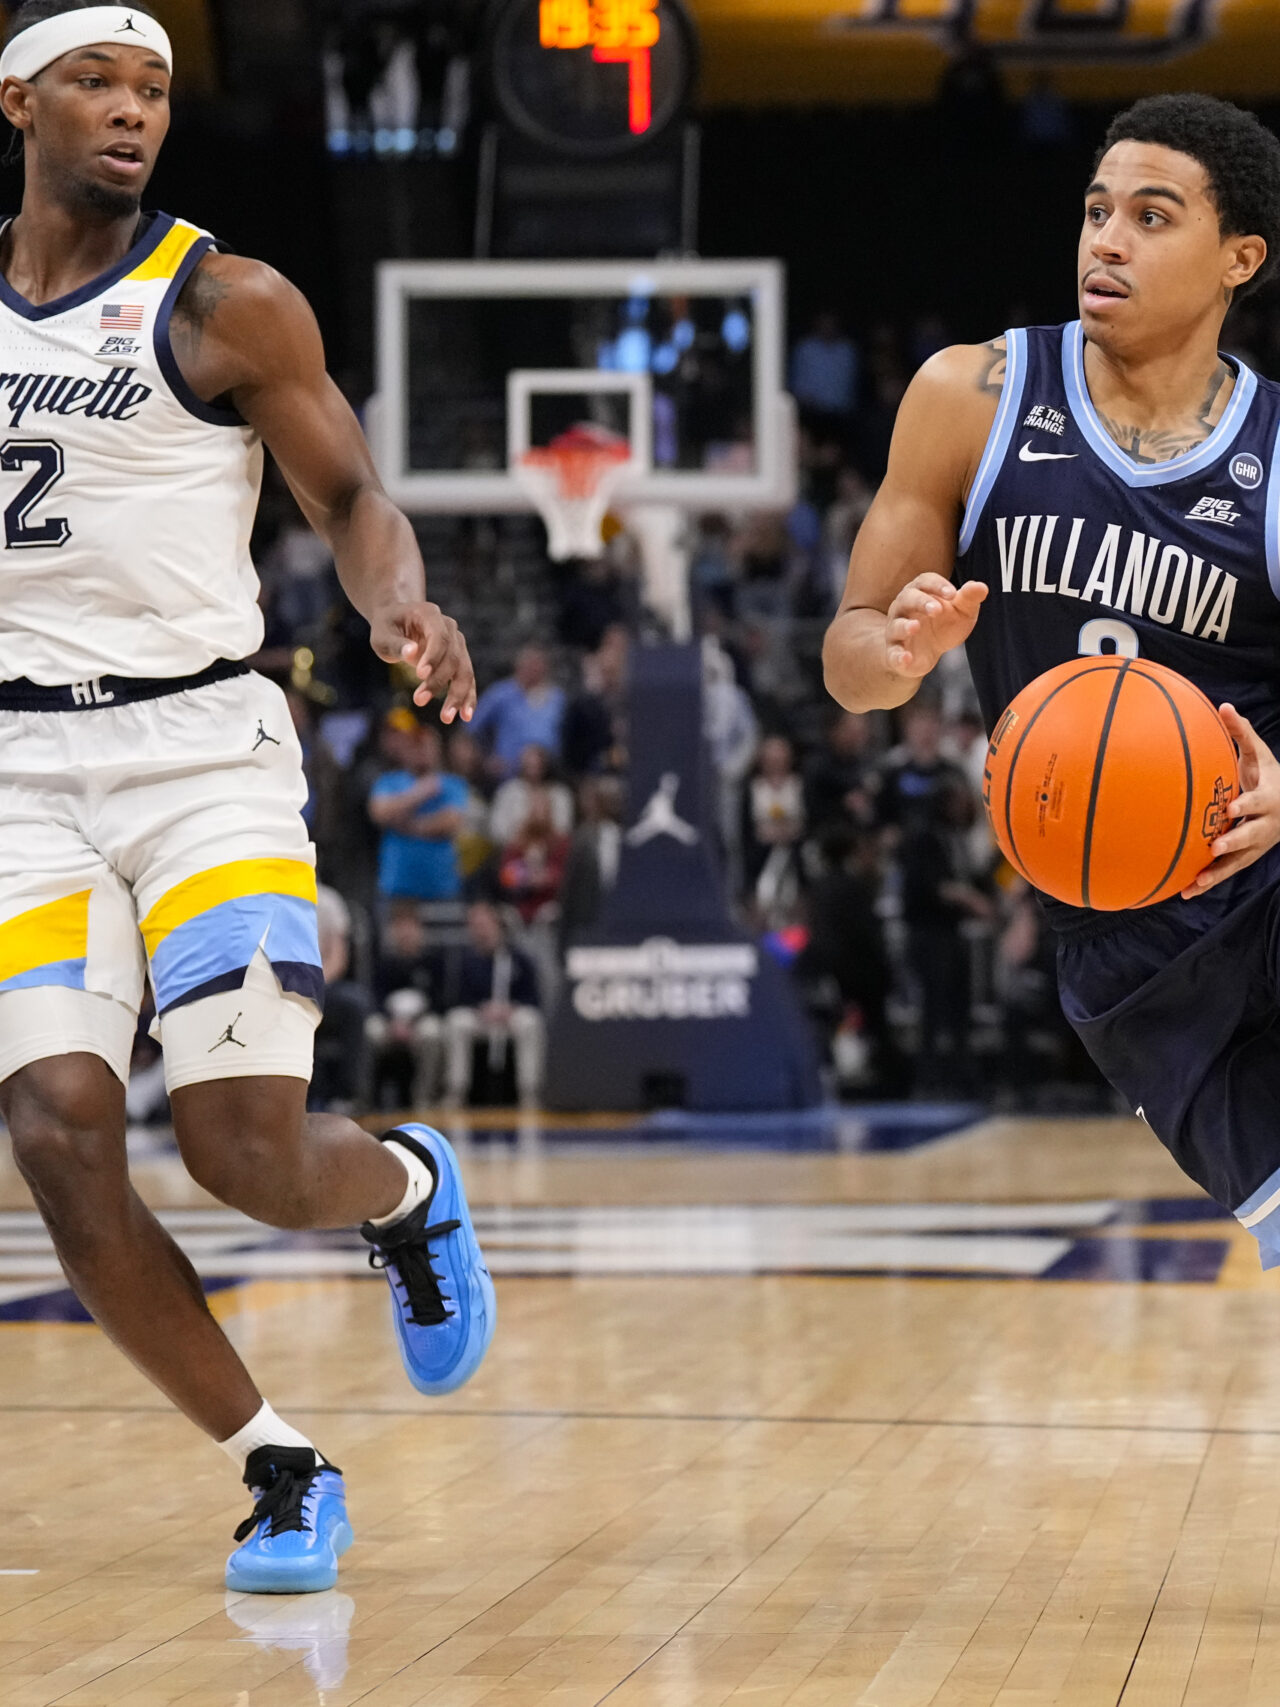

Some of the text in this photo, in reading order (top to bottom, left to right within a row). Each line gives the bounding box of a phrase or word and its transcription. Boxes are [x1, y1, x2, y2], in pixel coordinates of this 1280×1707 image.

[98, 346, 142, 354] EAST
[105, 336, 136, 345] BIG
[1023, 414, 1065, 437] CHANGE
[1030, 405, 1067, 426] BE THE
[1235, 461, 1258, 481] GHR
[0, 439, 72, 550] 2
[1196, 496, 1235, 511] BIG
[1188, 505, 1242, 522] EAST
[995, 514, 1239, 644] VILLANOVA
